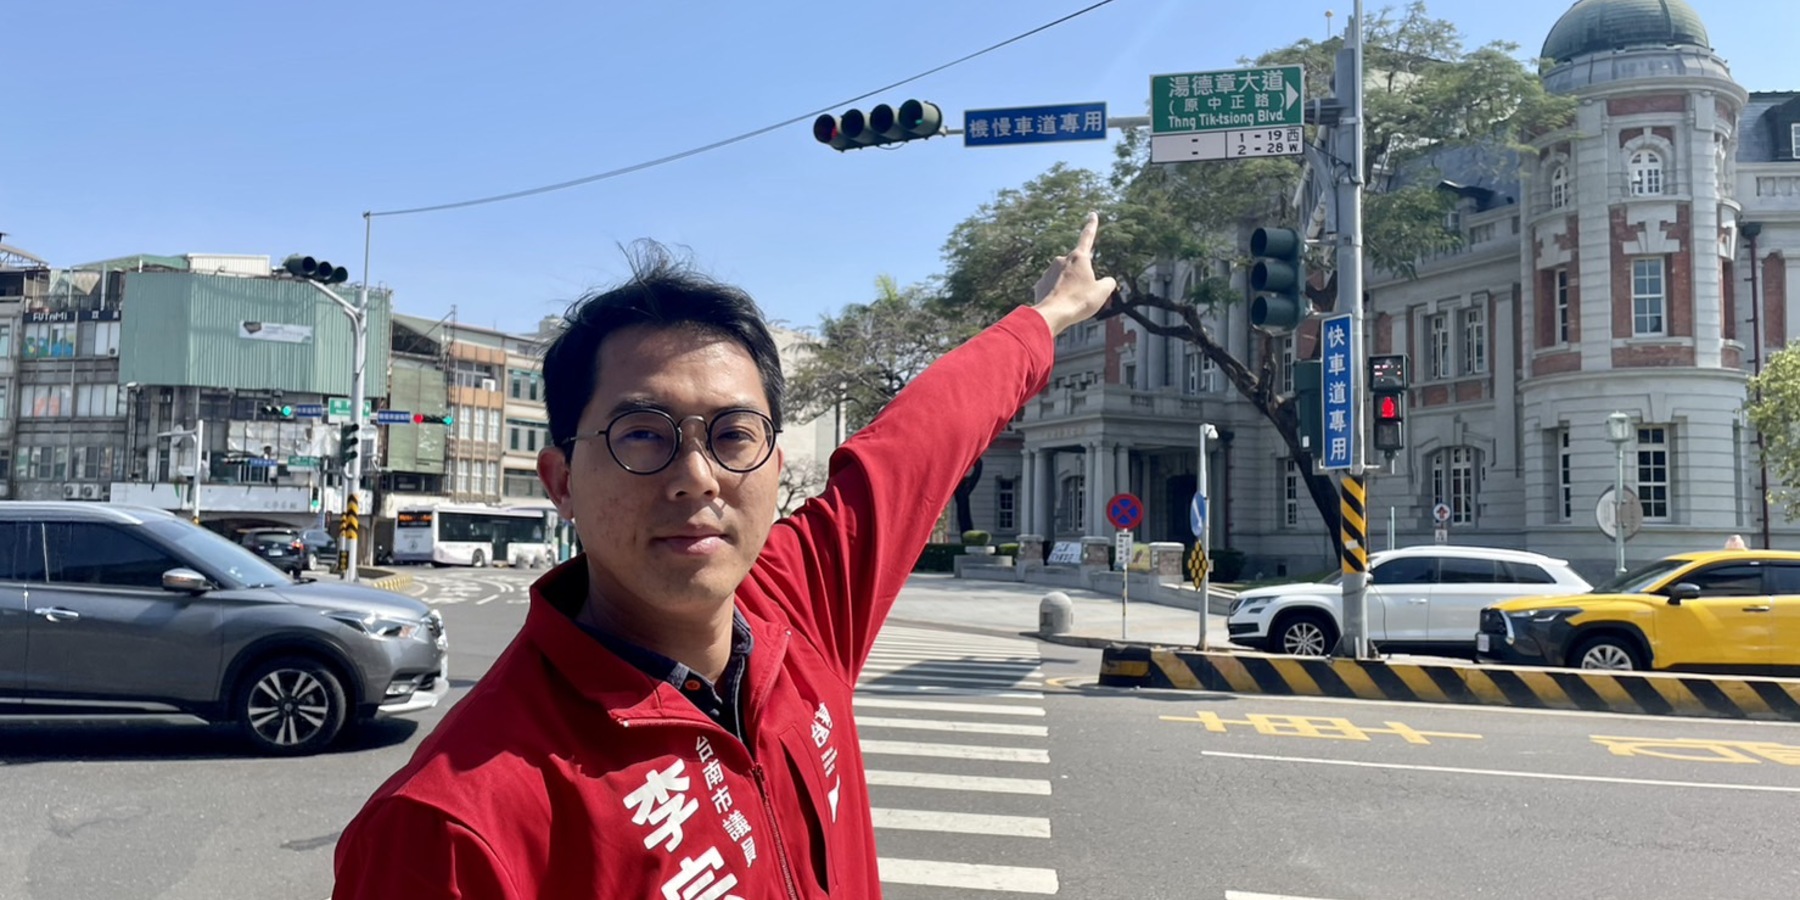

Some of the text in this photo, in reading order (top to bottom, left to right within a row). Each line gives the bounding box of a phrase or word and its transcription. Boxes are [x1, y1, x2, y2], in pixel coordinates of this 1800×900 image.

[1168, 70, 1284, 98] 湯德章大道
[1168, 93, 1285, 115] (原中正路)
[968, 110, 1103, 138] 機慢車道專用
[1168, 109, 1285, 130] Thng Tik-tsiong Blvd.
[1238, 133, 1245, 143] 1
[1267, 130, 1282, 141] 19
[1287, 128, 1299, 142] 西
[1237, 145, 1246, 155] 2
[1267, 143, 1284, 153] 28
[1288, 144, 1298, 152] W
[1327, 324, 1347, 461] 快車道專用
[695, 735, 757, 868] 台南市議員
